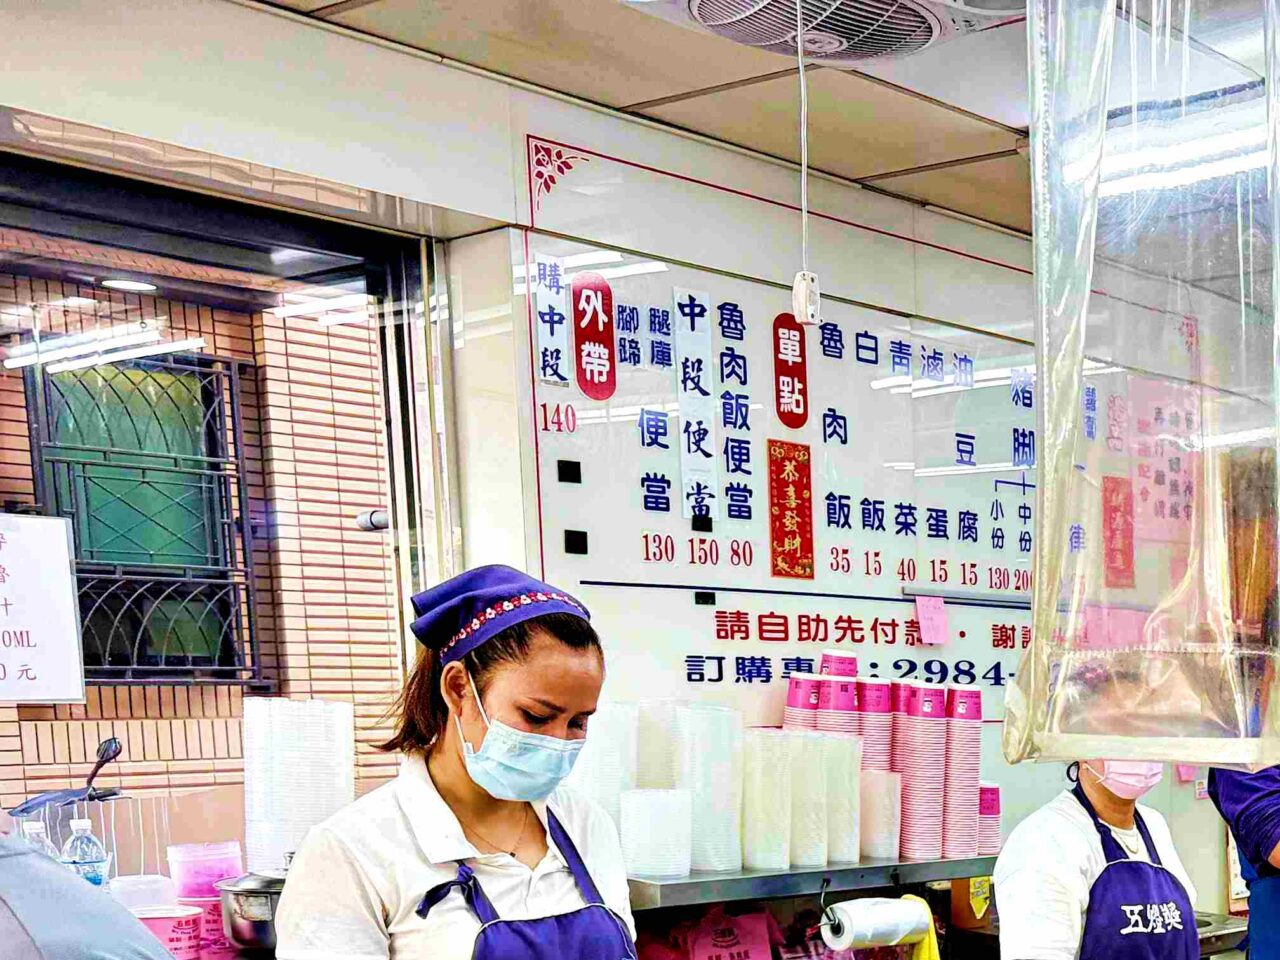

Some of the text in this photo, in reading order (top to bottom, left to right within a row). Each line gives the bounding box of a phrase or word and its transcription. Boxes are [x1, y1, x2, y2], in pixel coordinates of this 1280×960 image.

[578, 289, 611, 384] 外帶
[777, 327, 805, 416] 單點
[540, 403, 577, 434] 140
[716, 302, 753, 520] 魯肉飯便當
[637, 407, 671, 513] 便當
[780, 460, 802, 558] 恭喜發財
[990, 498, 1006, 550] 小份
[1017, 502, 1033, 553] 中份
[641, 533, 676, 562] 130
[687, 538, 720, 566] 150
[730, 540, 754, 567] 80
[830, 546, 851, 574] 35
[863, 551, 883, 577] 15
[896, 558, 917, 583] 40
[929, 559, 949, 583] 15
[960, 563, 979, 586] 15
[988, 567, 1010, 590] 130
